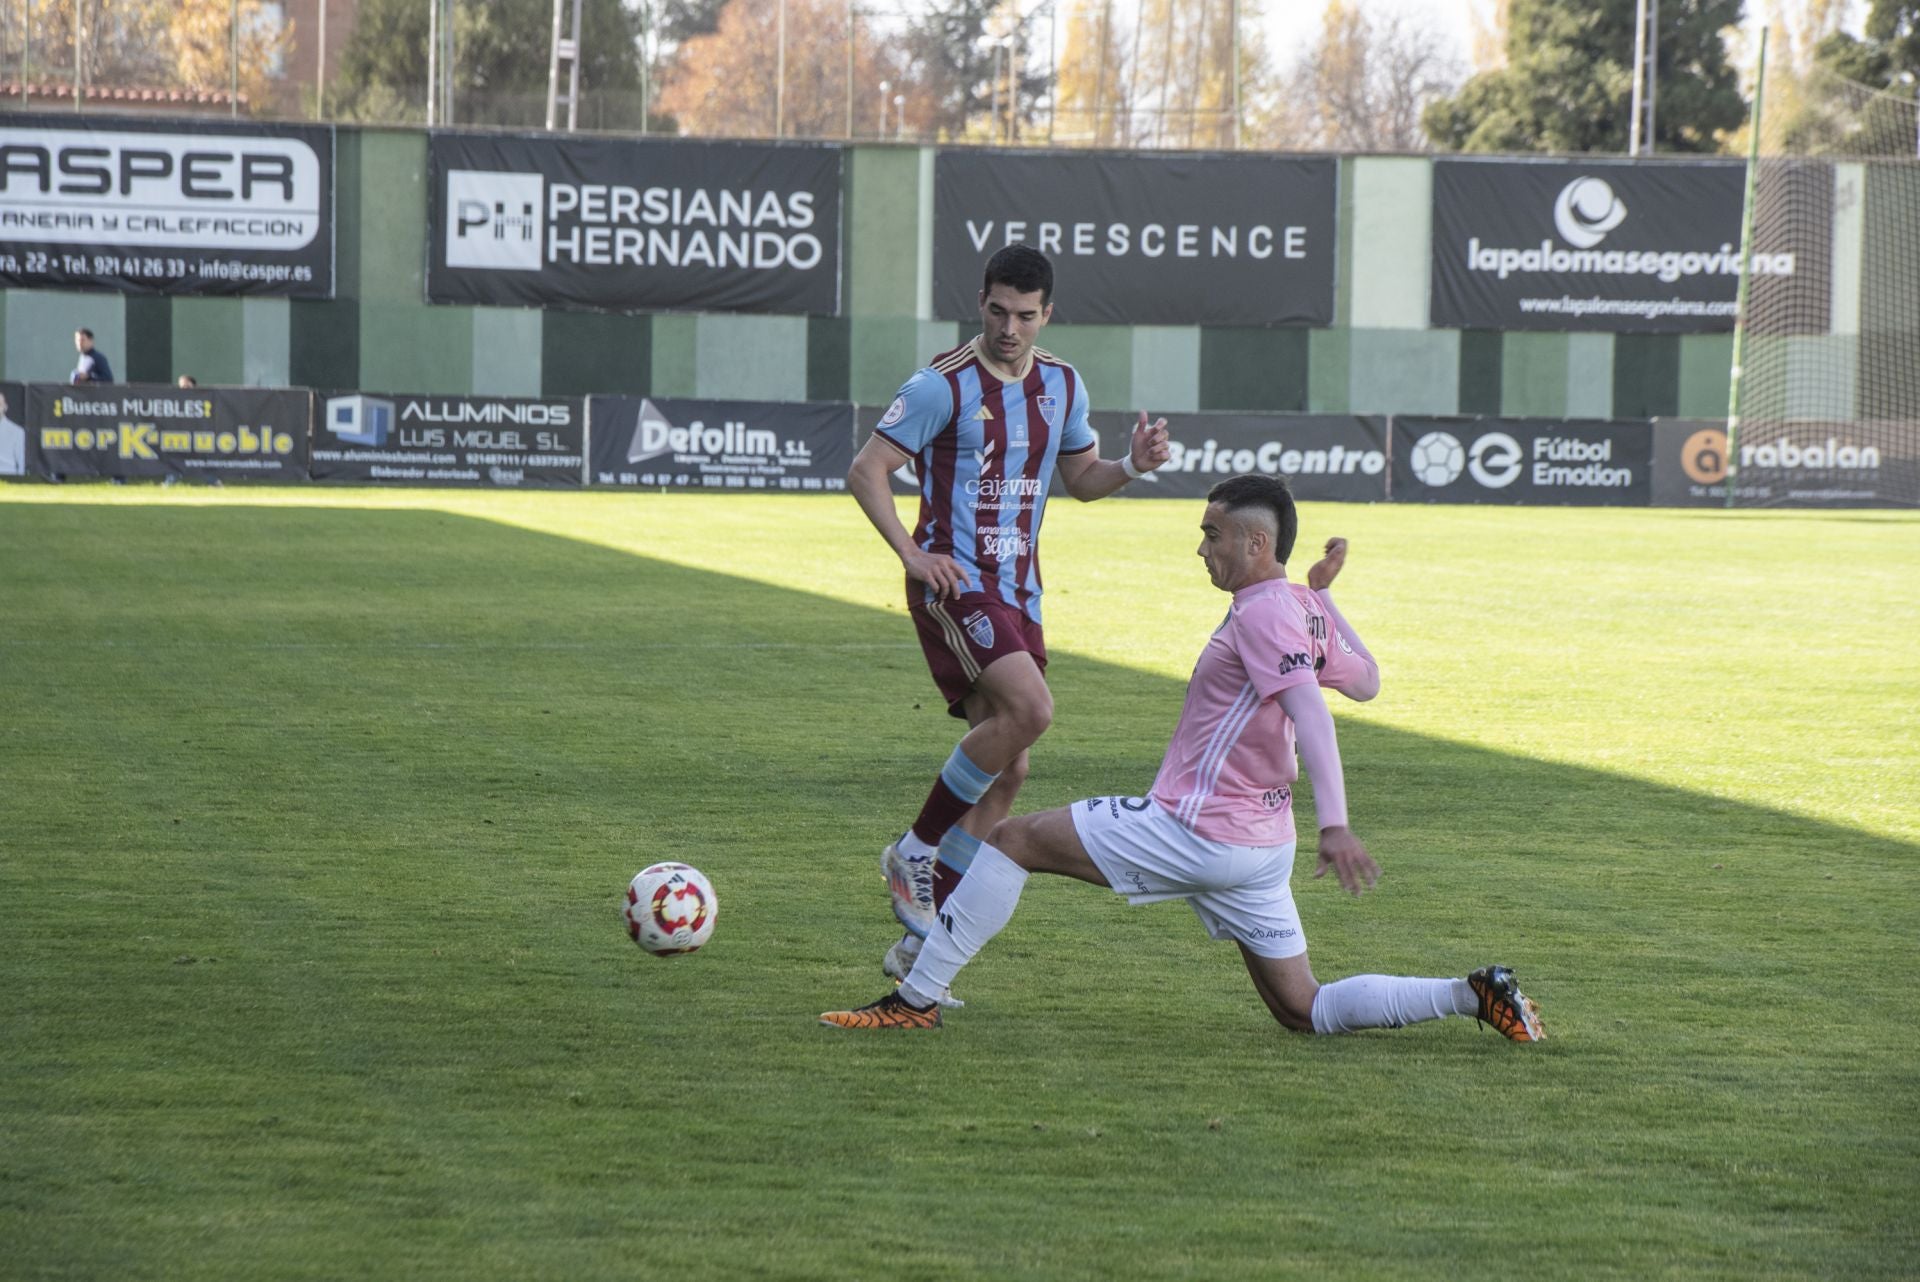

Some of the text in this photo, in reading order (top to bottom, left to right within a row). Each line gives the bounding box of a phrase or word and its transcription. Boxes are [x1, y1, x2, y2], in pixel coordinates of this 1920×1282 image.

[549, 183, 815, 229] PERSIANAS
[548, 226, 823, 270] HERNANDO
[966, 219, 1307, 259] VERESCENCE
[25, 251, 47, 273] 22
[401, 400, 570, 426] ALUMINIOS
[400, 428, 445, 447] LUIS
[453, 430, 528, 450] MIGUEL
[1533, 437, 1612, 462] Fútbol
[1165, 439, 1386, 475] BricoCentro
[964, 474, 1043, 502] cajaviva
[1532, 463, 1633, 487] Emotion
[1265, 928, 1297, 939] AFESA
